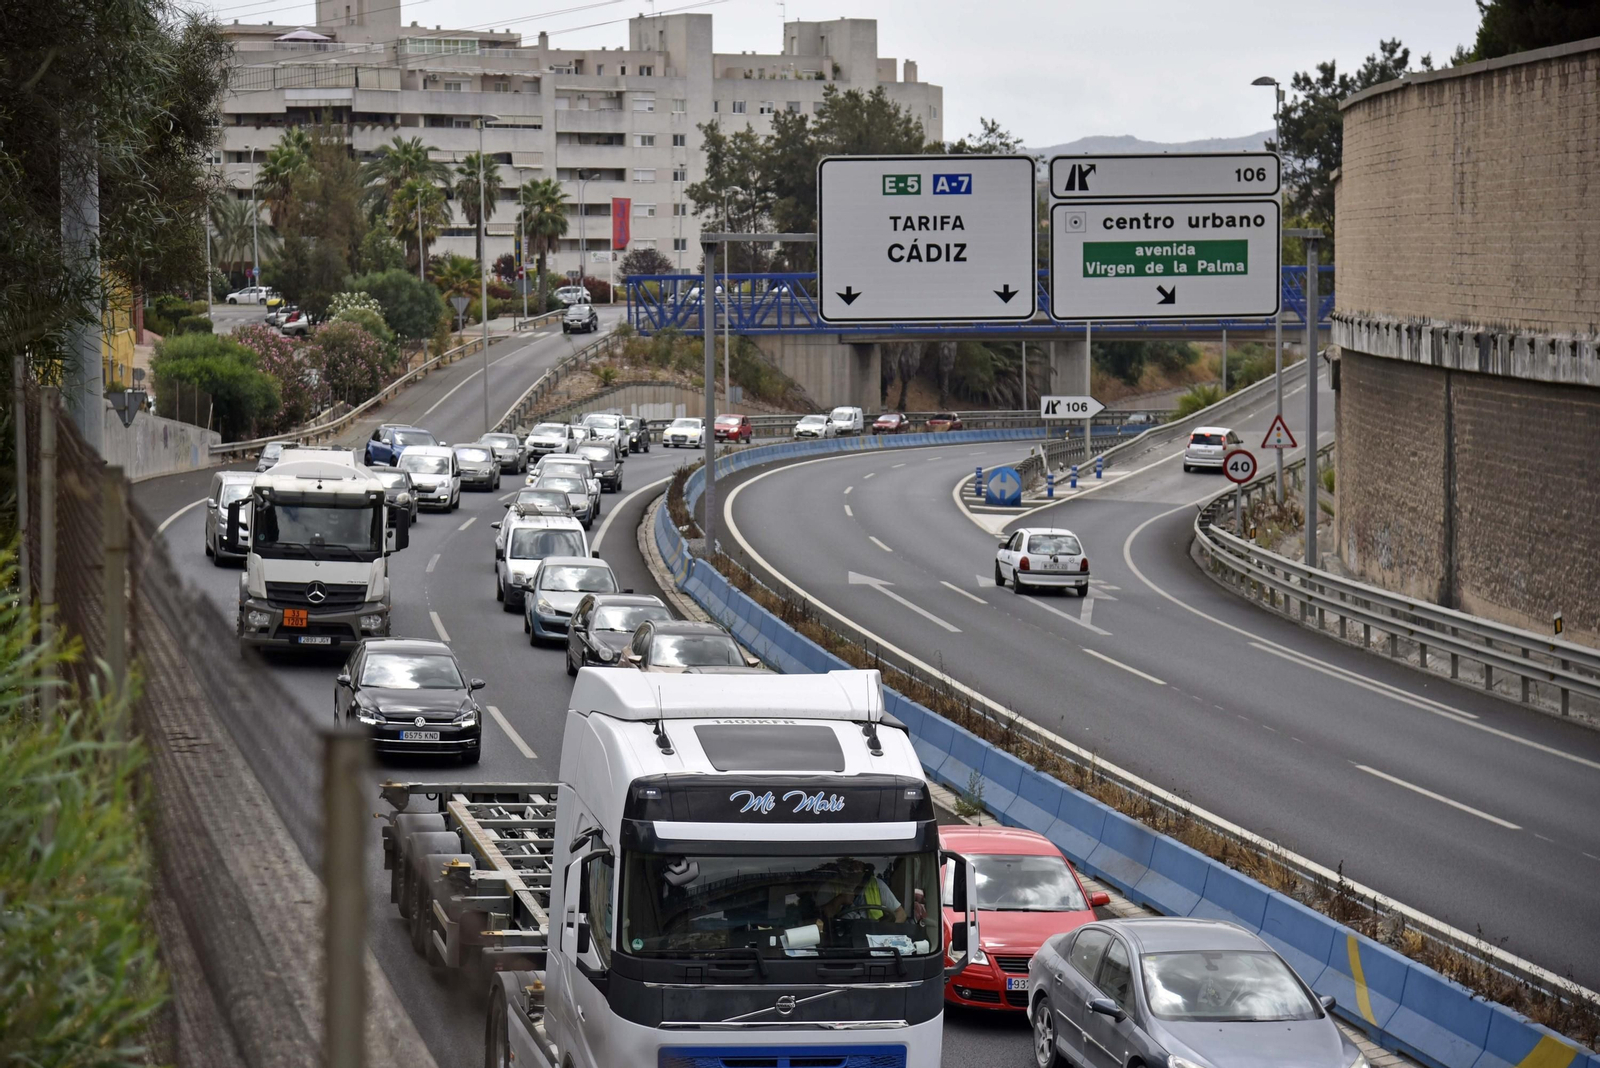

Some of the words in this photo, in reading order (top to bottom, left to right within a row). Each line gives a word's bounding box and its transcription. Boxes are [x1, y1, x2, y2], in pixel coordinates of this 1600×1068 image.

[1235, 167, 1266, 183] 106
[884, 176, 919, 193] E-5
[935, 176, 970, 193] A-7
[889, 215, 965, 231] TARIFA
[1102, 212, 1175, 230] centro
[1188, 212, 1266, 229] urbano
[887, 238, 967, 263] CÁDIZ
[1135, 243, 1196, 256] avenida
[1086, 261, 1135, 277] Virgen
[1145, 261, 1164, 274] de
[1174, 260, 1187, 273] la
[1197, 260, 1245, 273] Palma
[1066, 402, 1088, 412] 106
[1229, 461, 1250, 472] 40
[287, 618, 304, 626] 1203
[404, 731, 423, 739] 6575
[424, 732, 439, 740] KND
[729, 790, 776, 814] Mi
[782, 791, 845, 814] Mari
